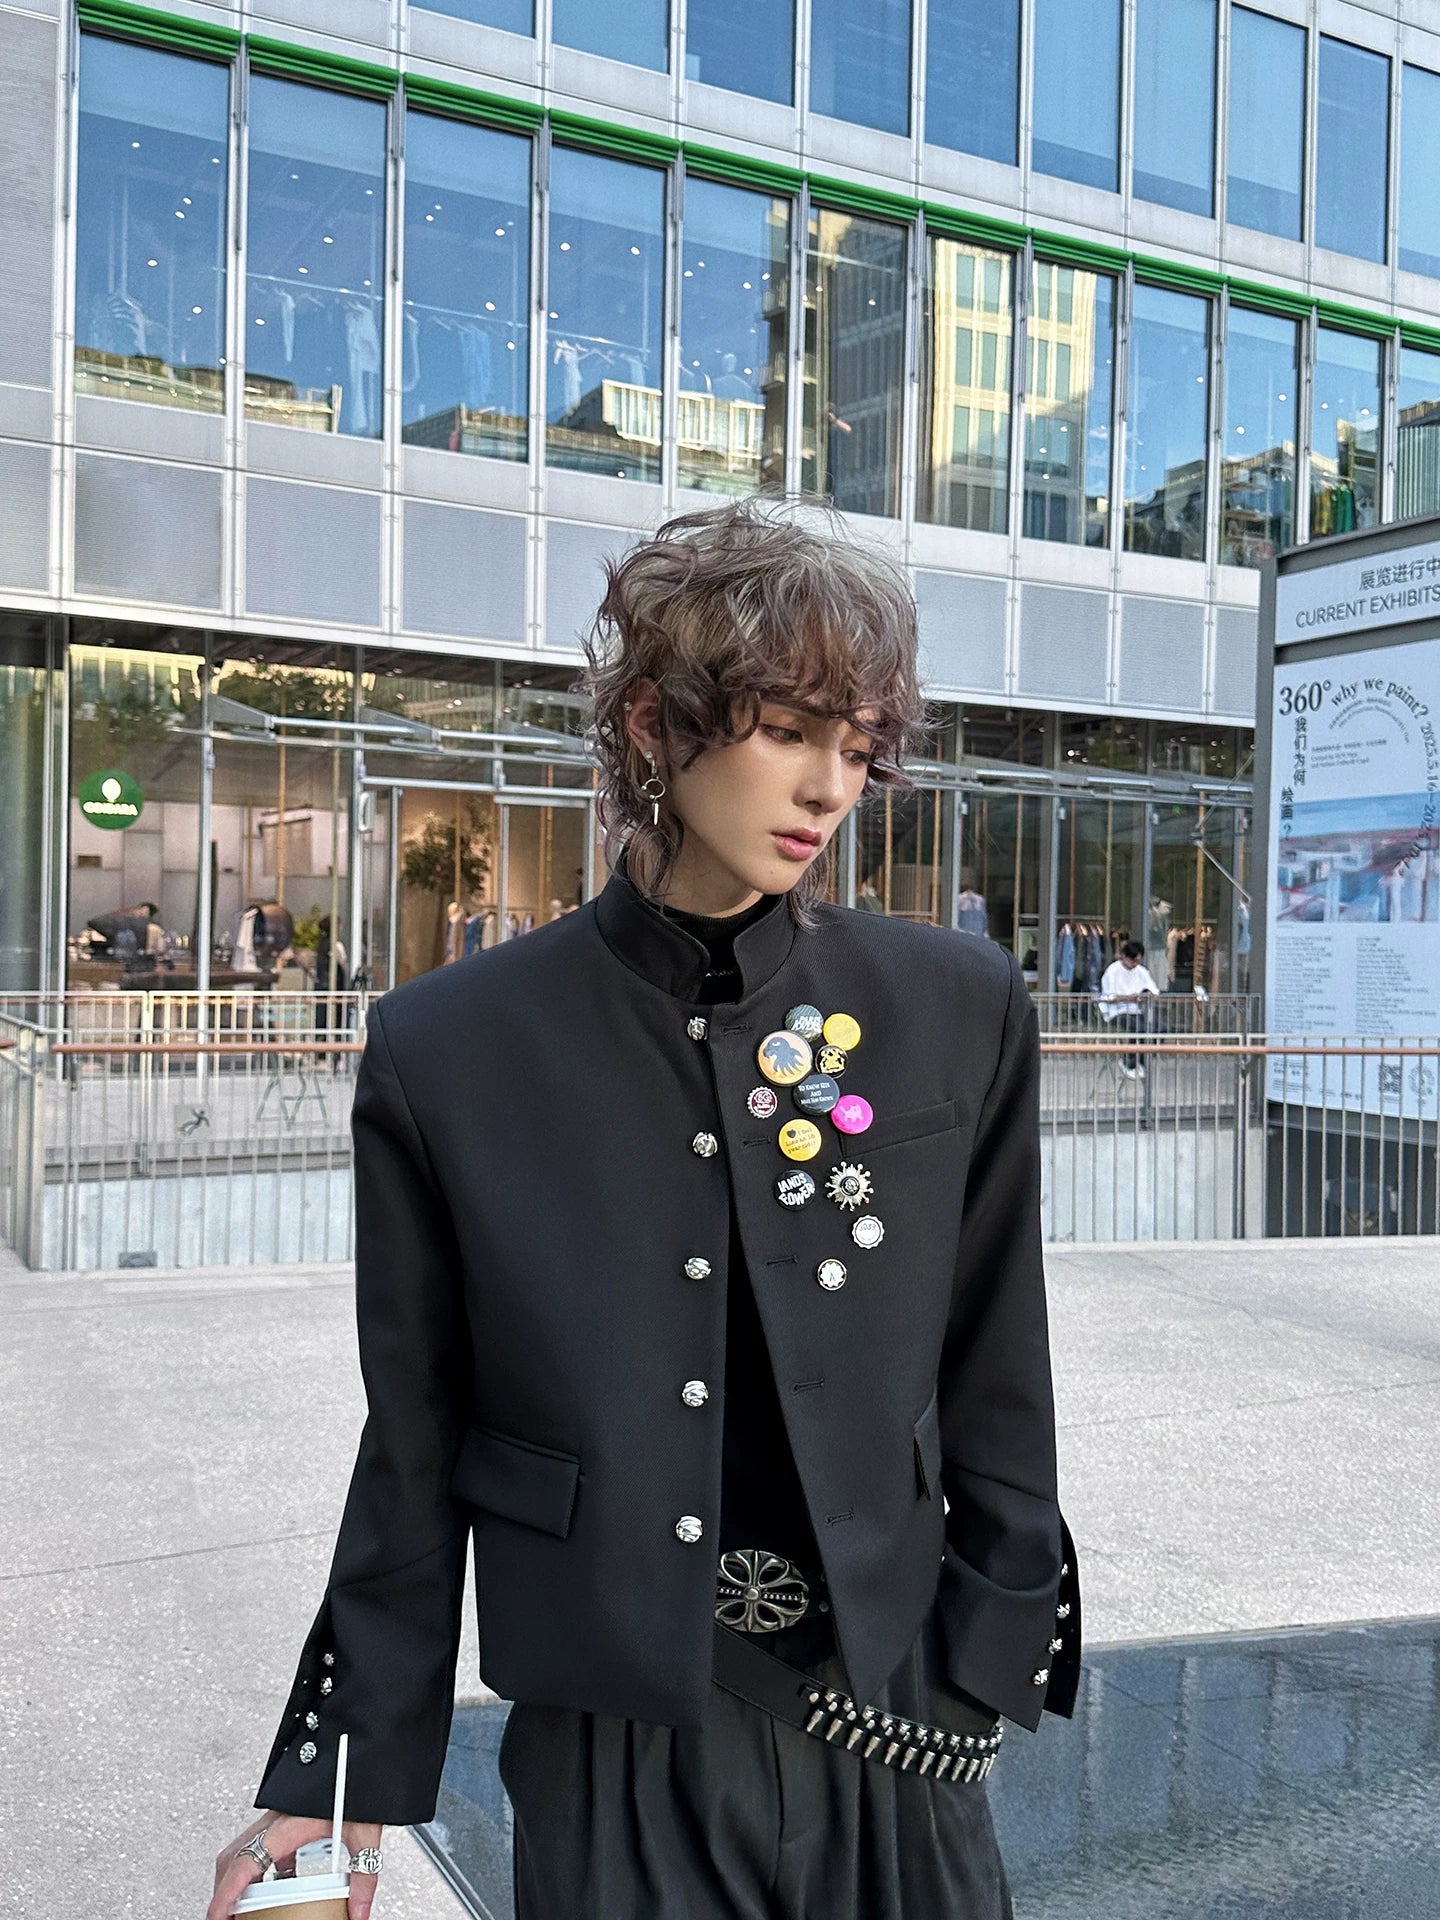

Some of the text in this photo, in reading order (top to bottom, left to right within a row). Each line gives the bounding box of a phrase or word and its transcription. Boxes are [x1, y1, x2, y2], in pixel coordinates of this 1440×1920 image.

[1295, 598, 1367, 629] CURRENT
[1279, 679, 1332, 716] 360°
[1331, 681, 1359, 707] why
[1363, 677, 1384, 691] we
[1385, 682, 1430, 719] paint?
[1293, 716, 1308, 786] 我们为何
[778, 1182, 816, 1206] POWER
